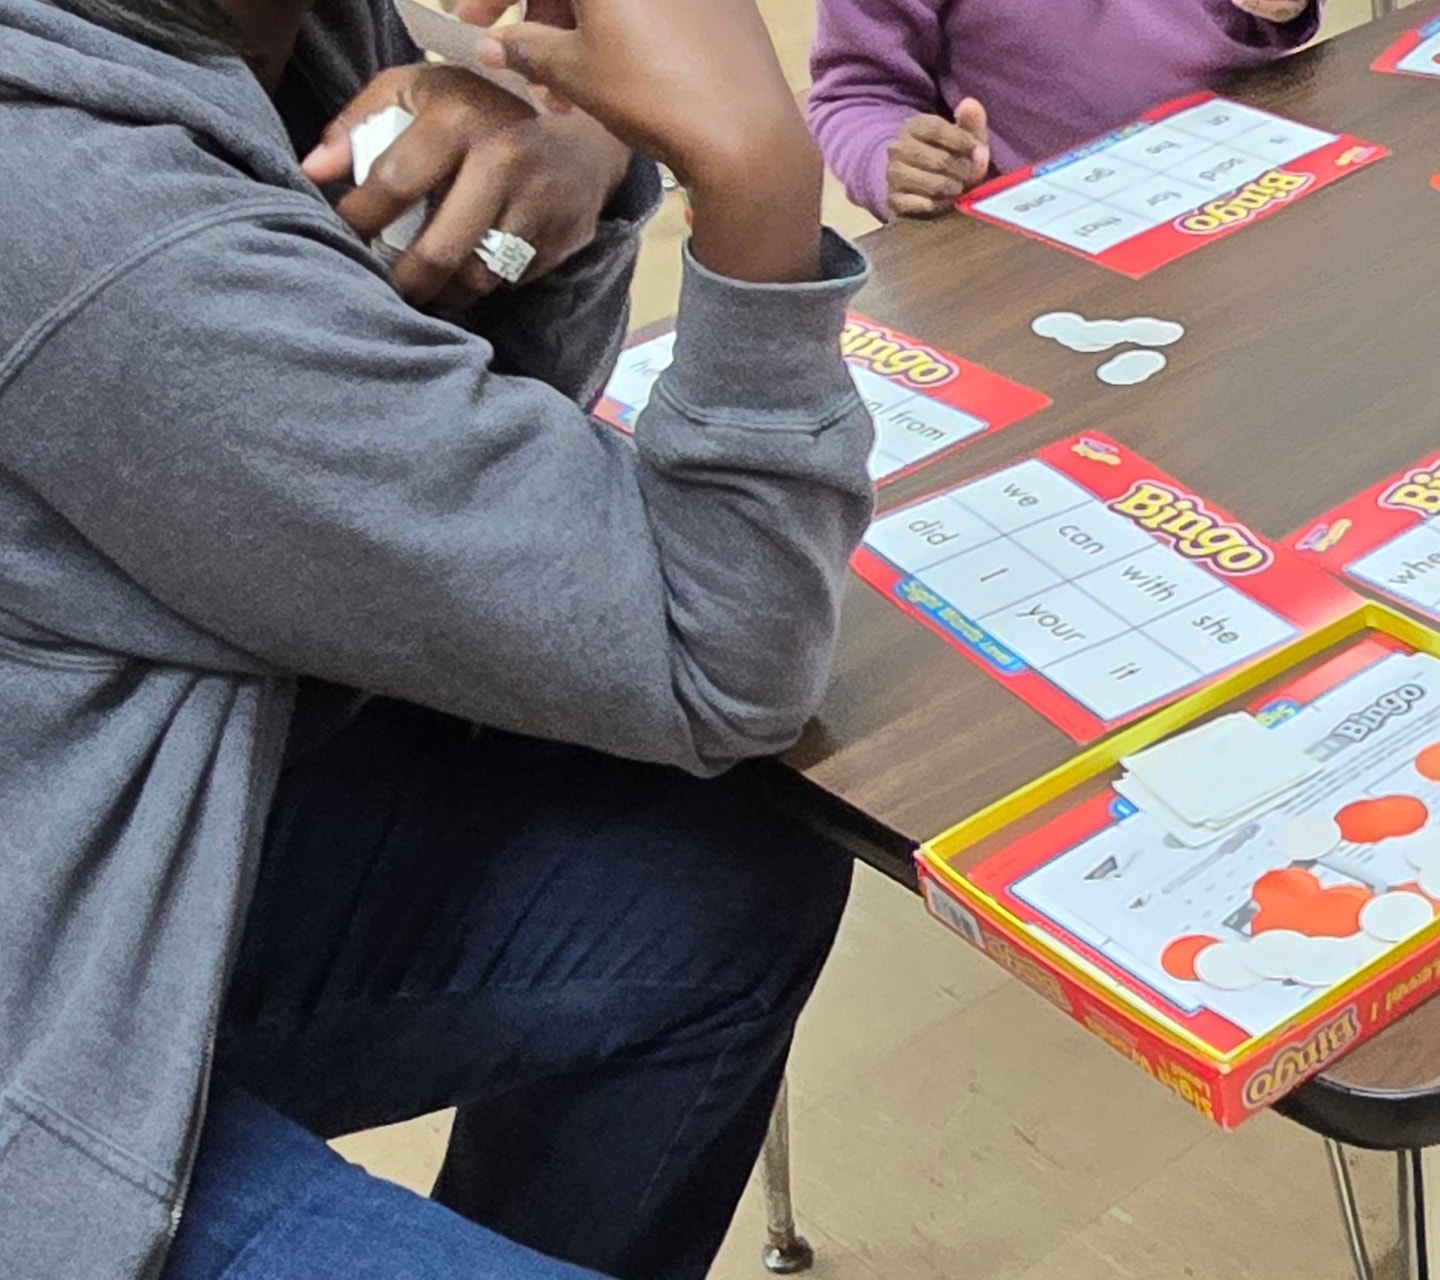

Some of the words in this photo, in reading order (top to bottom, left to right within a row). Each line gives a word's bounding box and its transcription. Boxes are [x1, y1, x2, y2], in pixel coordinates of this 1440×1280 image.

[1198, 156, 1246, 183] said
[1013, 192, 1057, 213] one
[1180, 169, 1309, 233] Bingo
[888, 409, 947, 442] from
[1002, 481, 1040, 508] we
[908, 516, 959, 549] did
[1057, 523, 1106, 556] can
[1109, 483, 1269, 573] Bingo
[979, 567, 1009, 585] I
[1120, 563, 1178, 604] with
[1016, 601, 1088, 644] your
[1191, 611, 1241, 646] she
[1109, 661, 1143, 684] it
[1331, 682, 1427, 744] Bingo
[1247, 1004, 1358, 1103] Bingo
